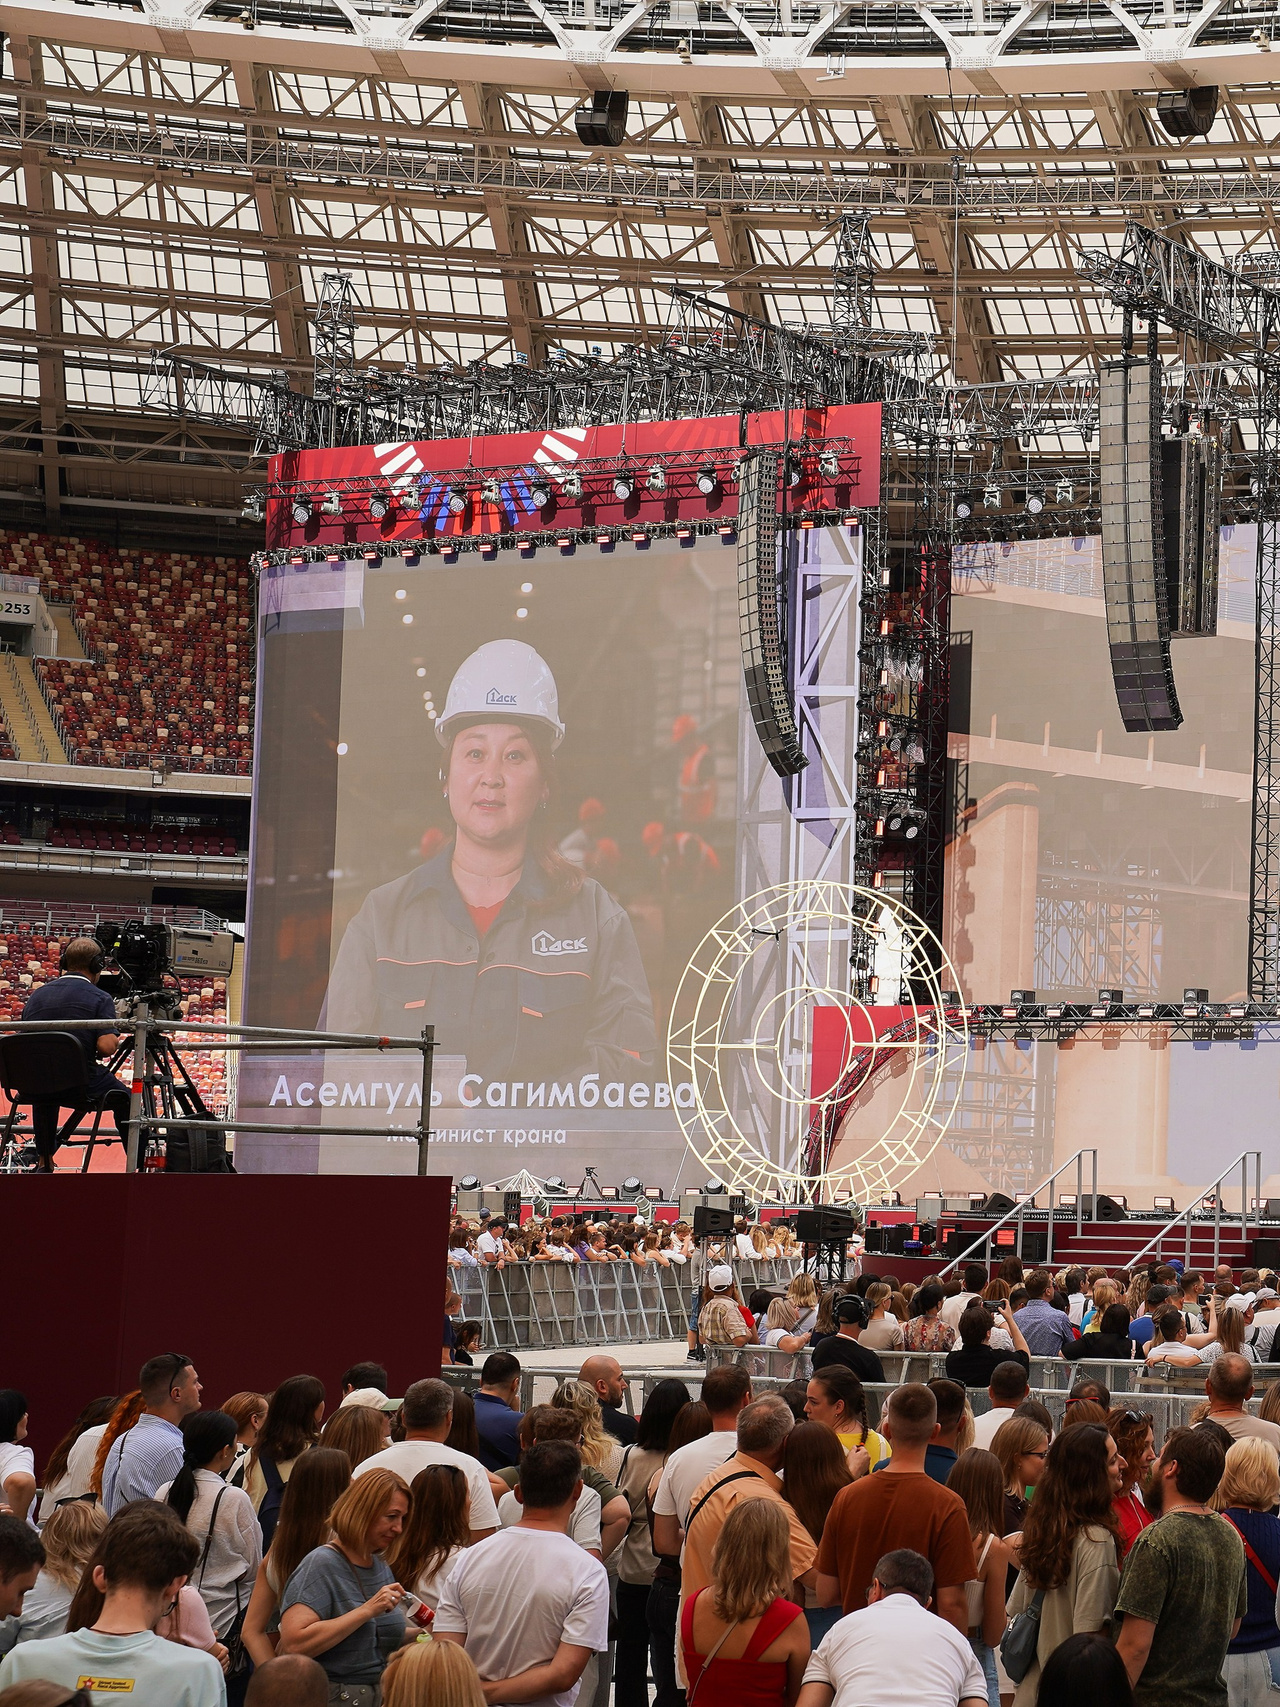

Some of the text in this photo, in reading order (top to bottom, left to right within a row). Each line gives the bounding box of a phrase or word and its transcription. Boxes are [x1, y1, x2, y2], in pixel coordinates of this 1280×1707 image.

[4, 602, 31, 615] 253
[268, 1073, 696, 1115] Асемгуль Сагимбаева
[503, 1127, 567, 1147] крана
